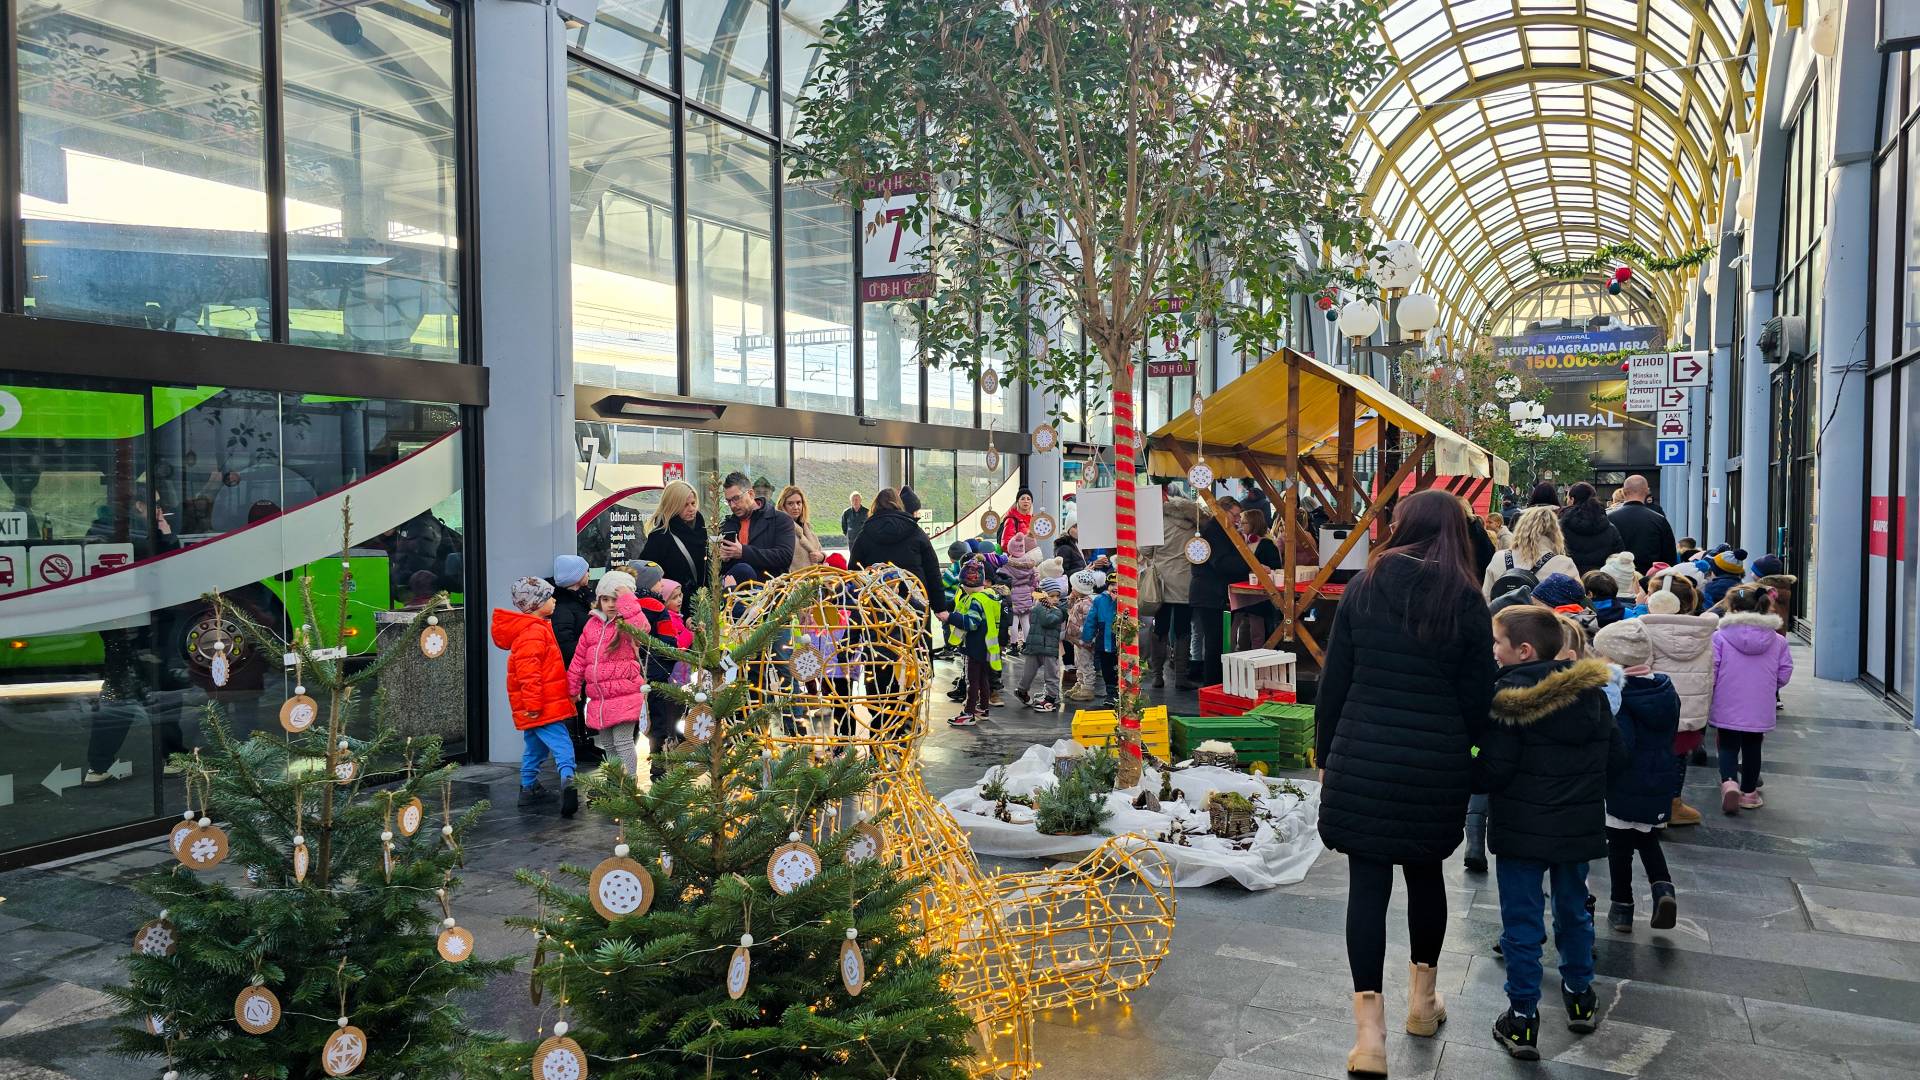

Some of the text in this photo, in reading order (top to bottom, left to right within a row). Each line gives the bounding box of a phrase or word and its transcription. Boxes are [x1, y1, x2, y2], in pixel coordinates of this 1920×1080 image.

[886, 208, 905, 263] 7
[869, 280, 926, 297] ODHO
[1498, 341, 1650, 356] SKUPNA NAGRADNA IGRA
[1633, 358, 1664, 367] IZHOD
[1664, 444, 1679, 461] P
[583, 437, 600, 490] 7
[610, 512, 629, 522] Odhodi
